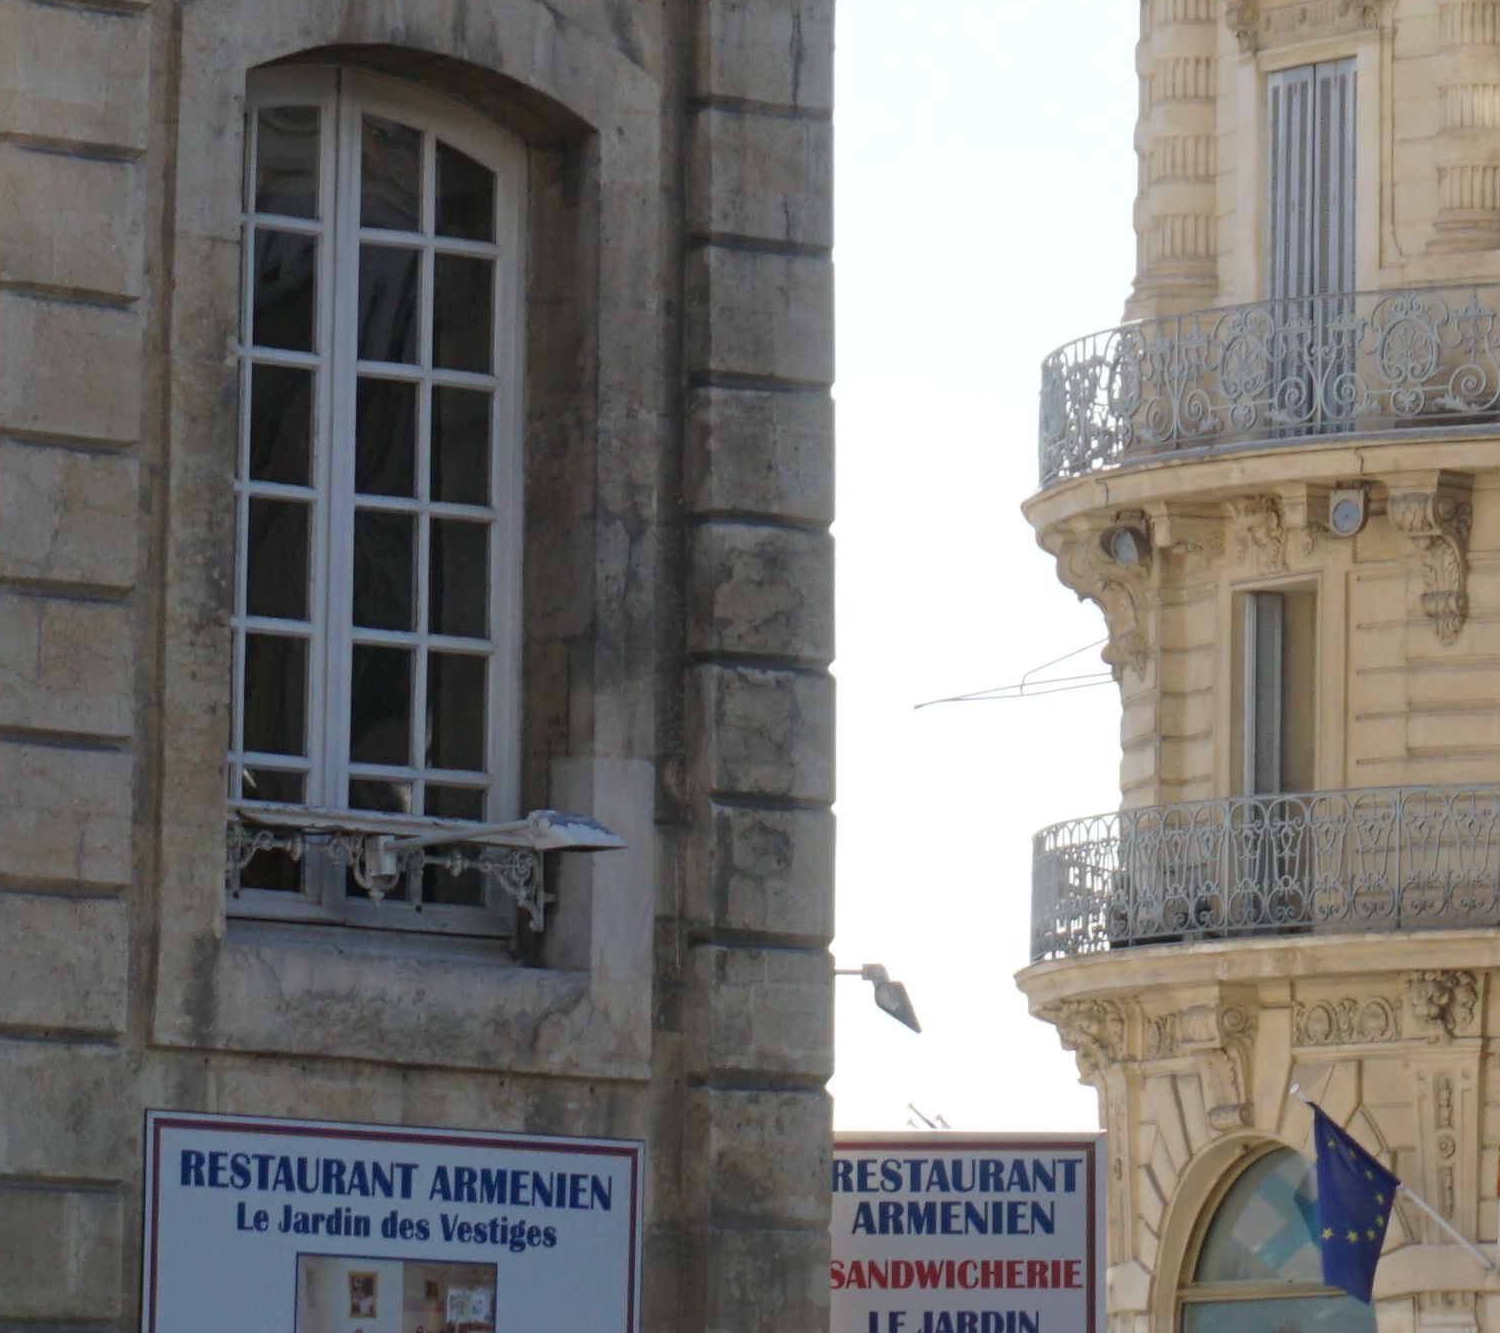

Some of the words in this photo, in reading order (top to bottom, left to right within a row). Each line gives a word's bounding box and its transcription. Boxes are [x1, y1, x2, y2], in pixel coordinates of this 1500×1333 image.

[180, 1149, 419, 1199] RESTAURANT
[429, 1164, 613, 1211] ARMENIEN
[832, 1158, 1082, 1193] RESTAURANT
[236, 1202, 270, 1232] Le
[277, 1203, 371, 1238] Jardin
[381, 1209, 431, 1241] des
[440, 1214, 558, 1253] Vestiges
[852, 1200, 1055, 1235] ARMENIEN
[829, 1259, 1083, 1290] SANDWICHERIE
[917, 1310, 1040, 1333] JARDIN
